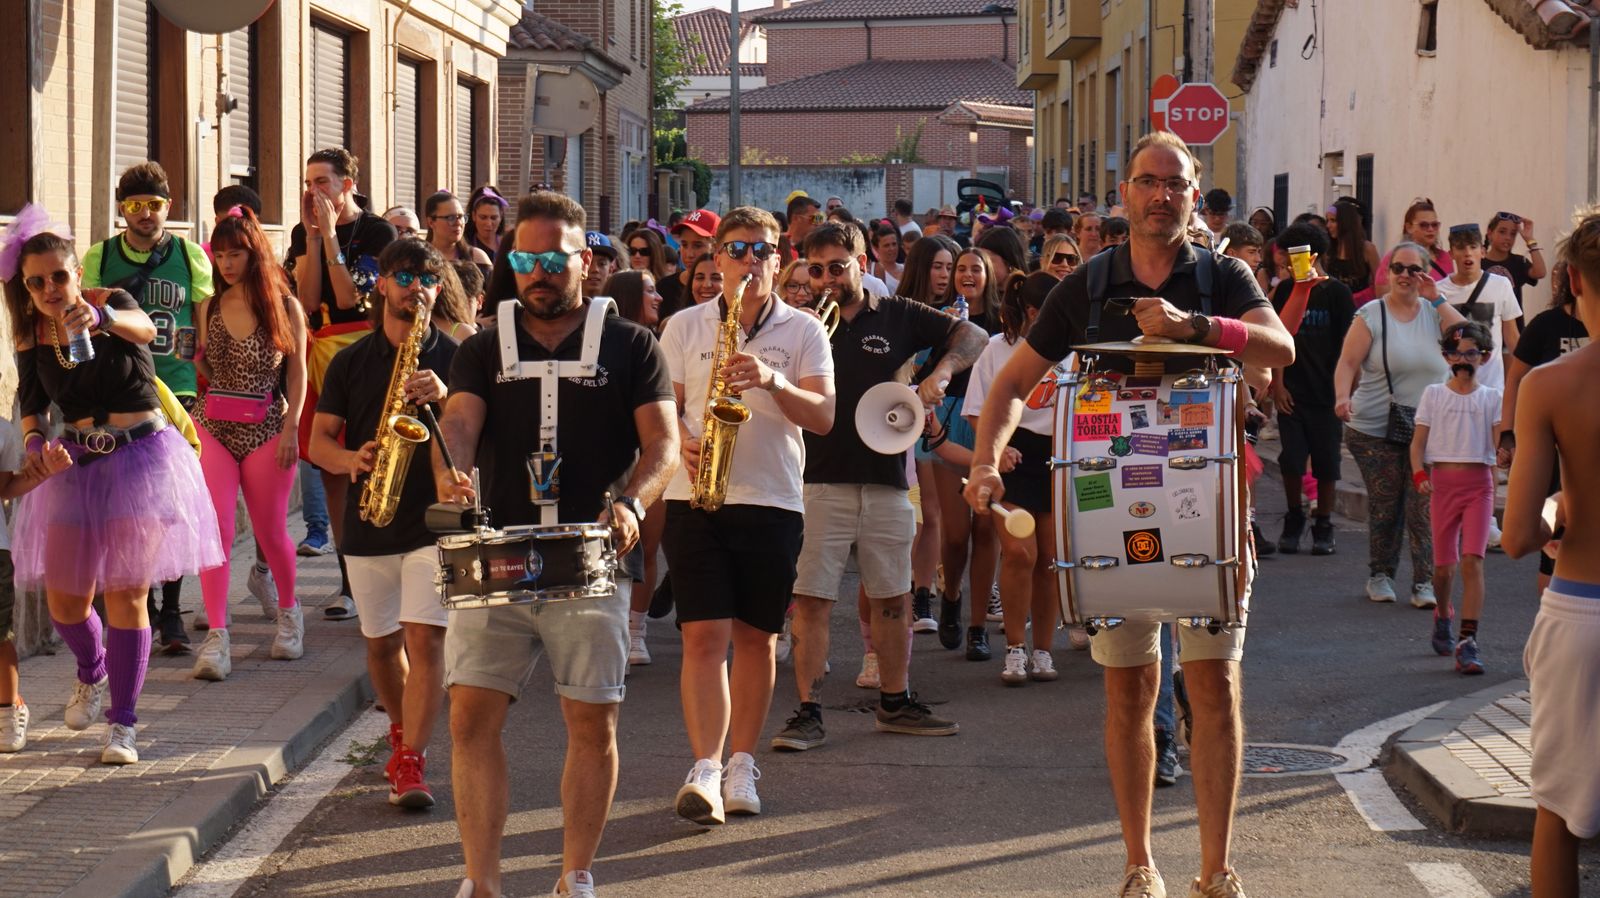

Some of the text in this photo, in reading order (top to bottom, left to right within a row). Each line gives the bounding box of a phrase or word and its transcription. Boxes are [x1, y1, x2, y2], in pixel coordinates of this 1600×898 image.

[1171, 106, 1225, 121] STOP
[688, 212, 701, 221] NY
[588, 234, 600, 246] NY
[770, 360, 781, 369] DEL
[583, 379, 598, 387] DEL
[1077, 413, 1118, 425] LA OSTIA
[1076, 424, 1118, 436] TORERA
